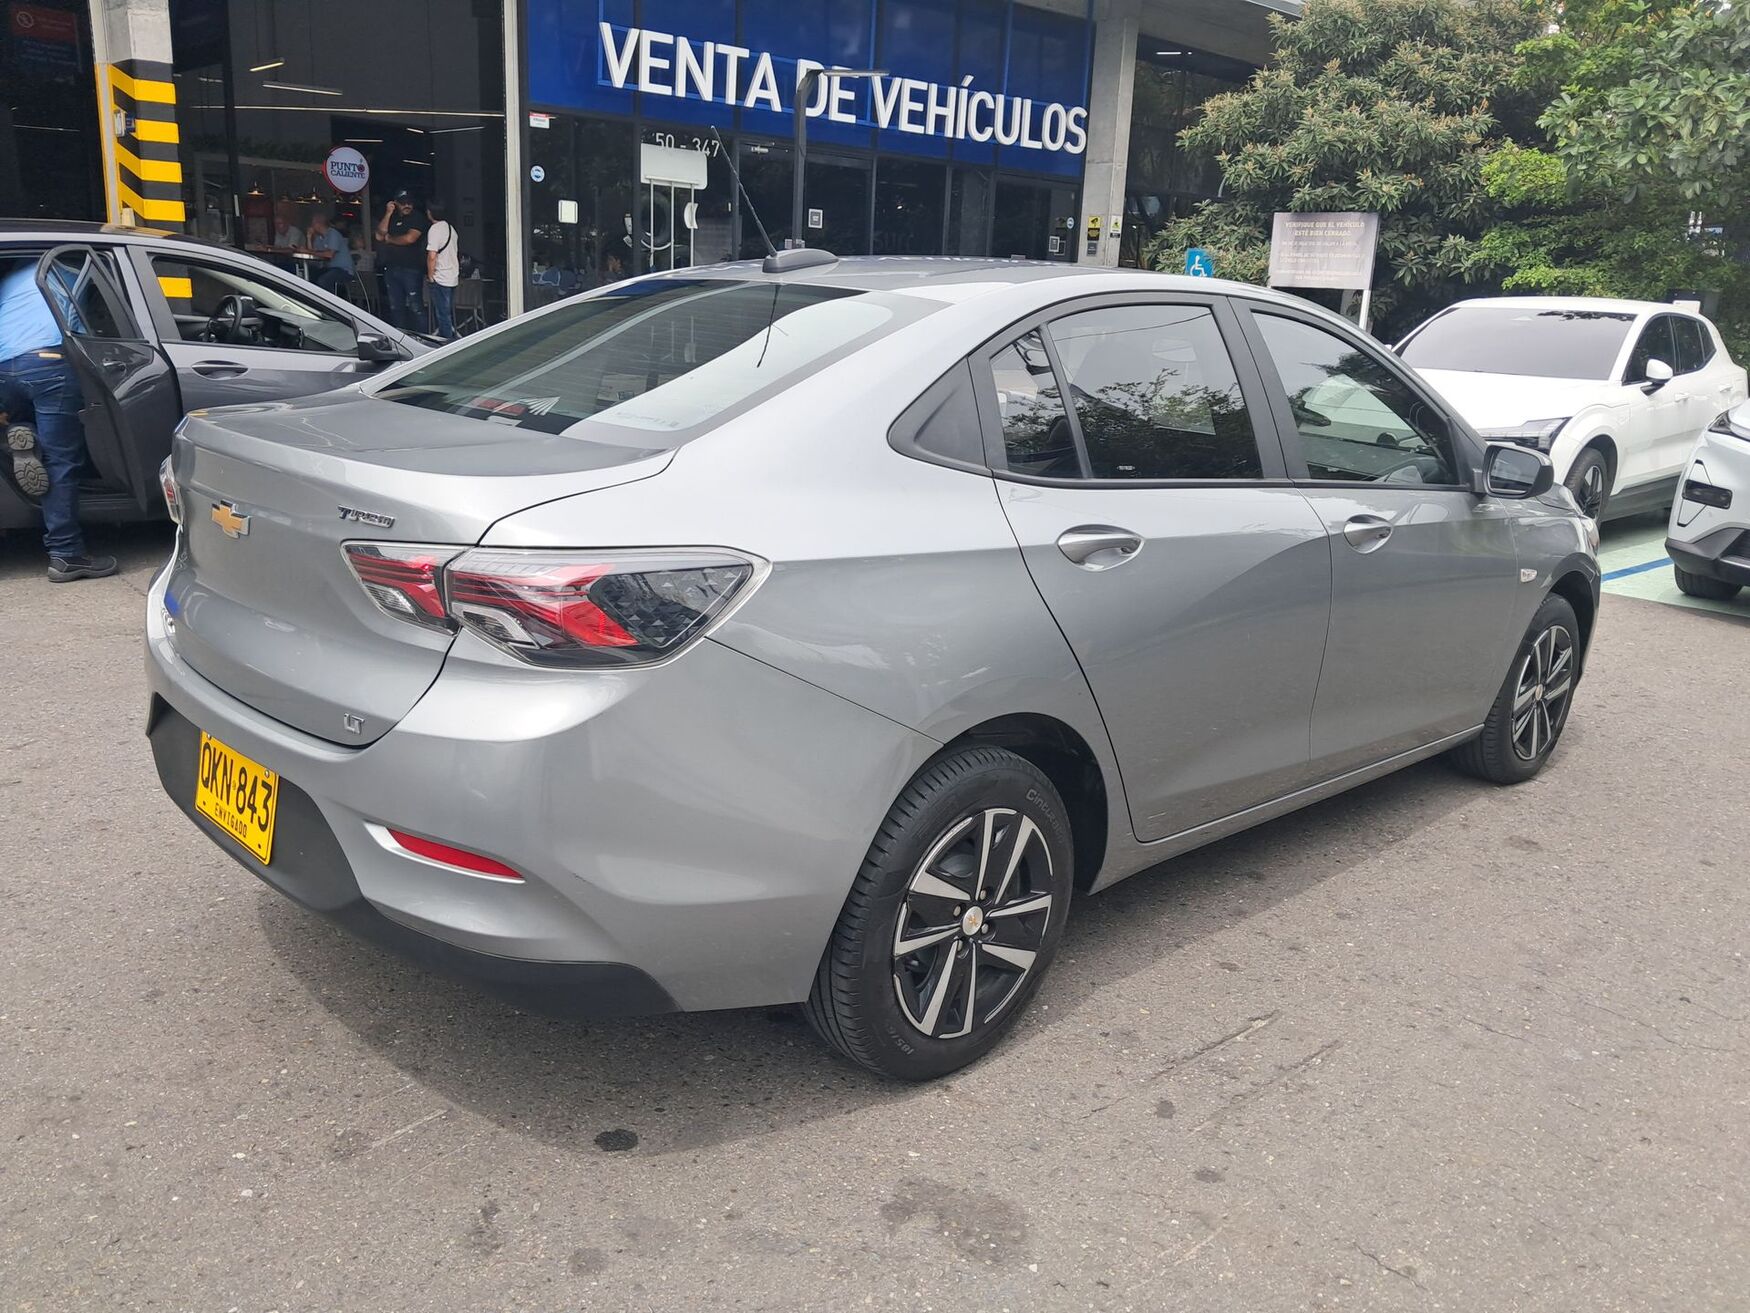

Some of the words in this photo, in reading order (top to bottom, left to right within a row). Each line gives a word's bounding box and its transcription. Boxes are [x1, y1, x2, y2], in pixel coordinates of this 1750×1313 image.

[599, 22, 782, 112] VENTA
[797, 59, 857, 123] DE
[871, 74, 1088, 154] VEHÍCULOS
[656, 132, 675, 149] 50
[692, 137, 720, 158] 347
[330, 161, 365, 173] PUNTO
[330, 169, 365, 179] CALIENTE
[343, 712, 365, 735] LT
[236, 766, 273, 832] 843
[214, 801, 248, 839] ENVIGADO
